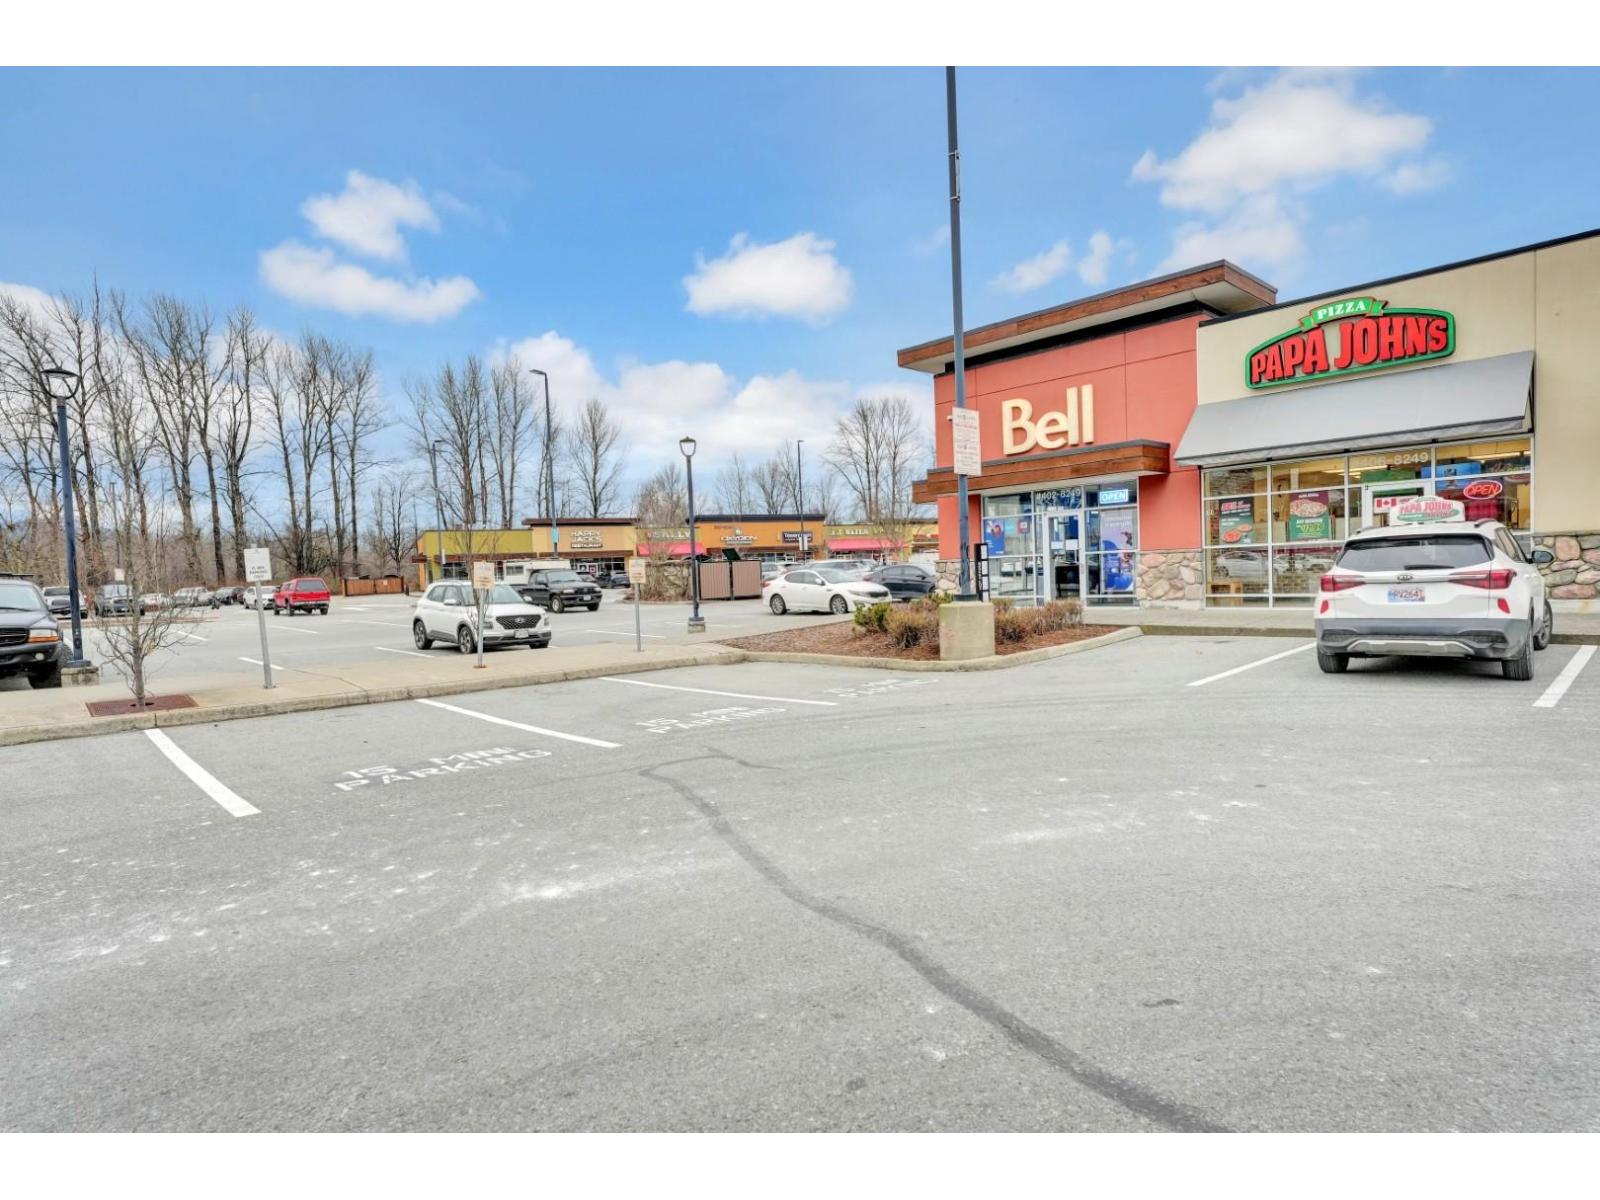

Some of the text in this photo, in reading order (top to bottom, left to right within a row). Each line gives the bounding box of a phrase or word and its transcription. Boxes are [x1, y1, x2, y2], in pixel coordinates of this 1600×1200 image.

[1316, 299, 1367, 321] PIZZA
[1251, 327, 1330, 384] PAPA
[1002, 384, 1095, 455] Bell
[1101, 492, 1126, 501] OPEN
[1469, 483, 1498, 496] OPEN
[647, 707, 787, 734] PARKING
[334, 749, 552, 791] PARKING
[342, 764, 398, 778] 15
